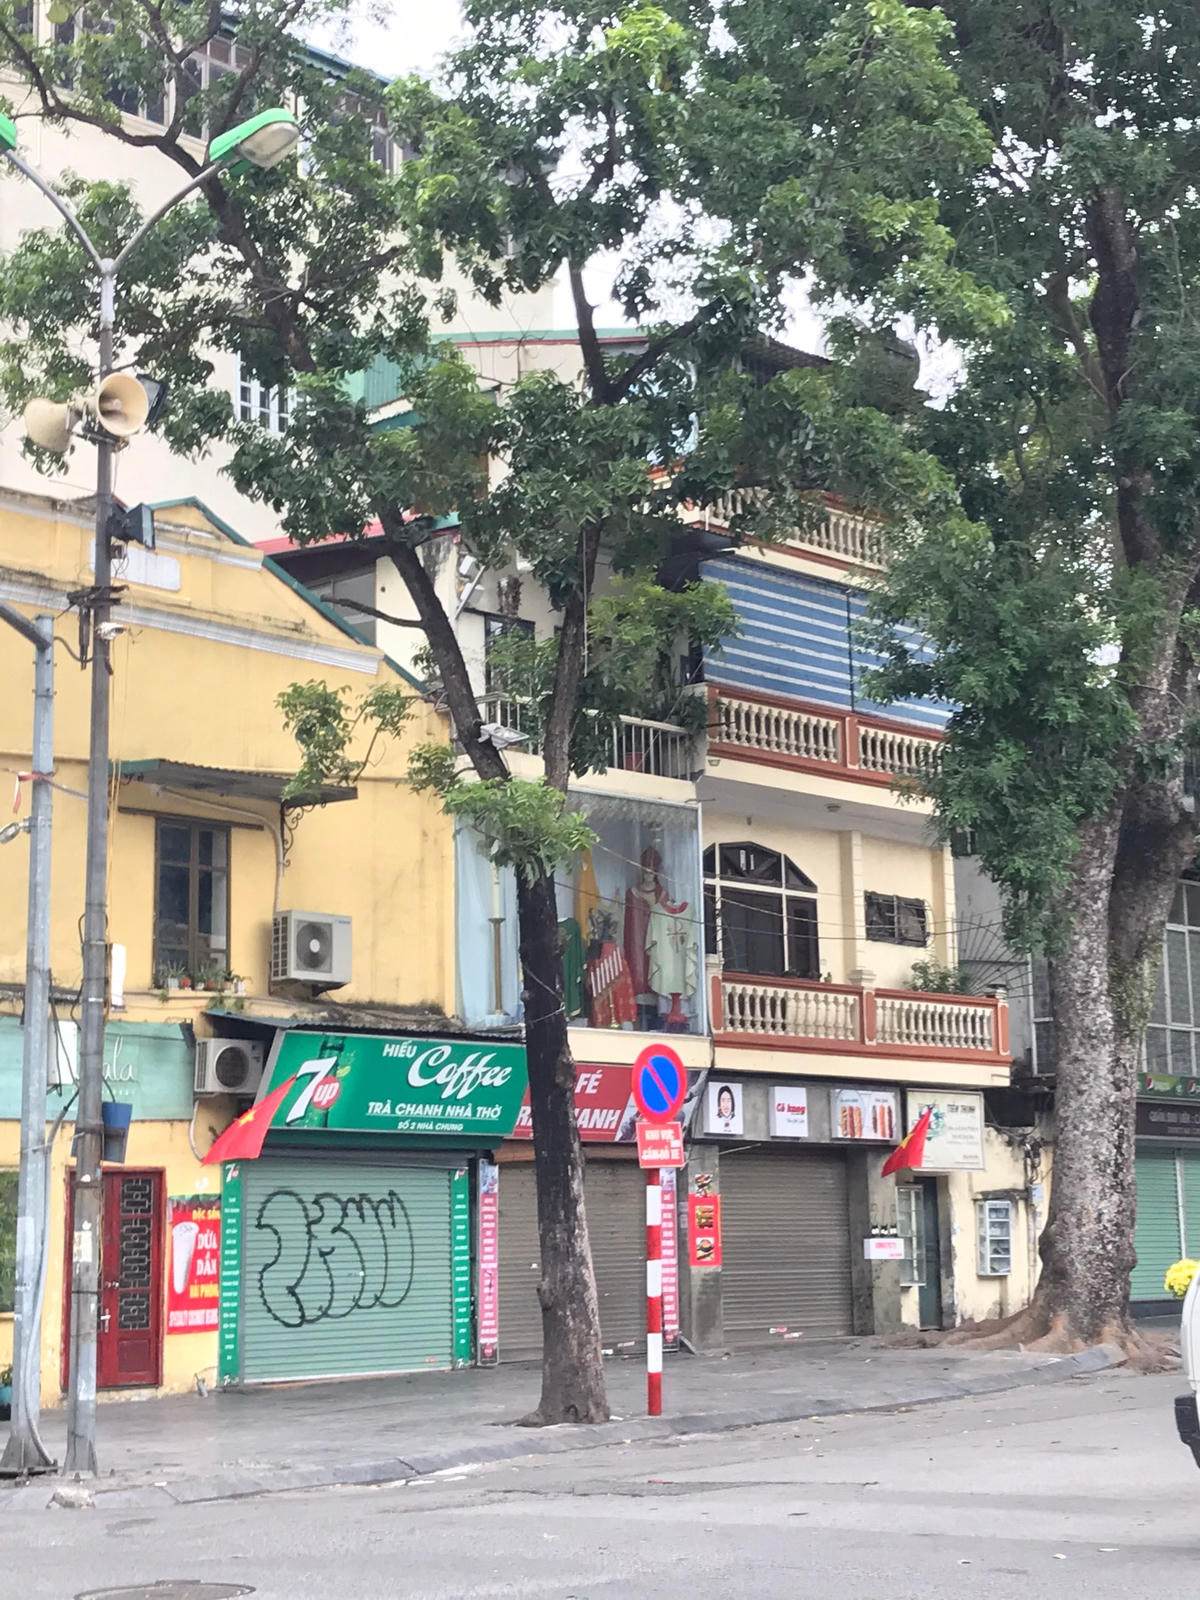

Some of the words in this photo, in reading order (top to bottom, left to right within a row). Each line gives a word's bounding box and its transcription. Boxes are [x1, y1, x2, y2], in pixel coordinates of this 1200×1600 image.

[382, 1040, 418, 1057] HIẾU
[407, 1045, 513, 1099] Coffee
[574, 1069, 603, 1094] FÉ
[367, 1100, 393, 1115] TRÀ
[395, 1103, 442, 1117] CHANH
[444, 1101, 473, 1117] NHÀ
[476, 1104, 503, 1118] THỜ
[575, 1107, 622, 1130] ANH
[435, 1122, 464, 1132] CHUNG
